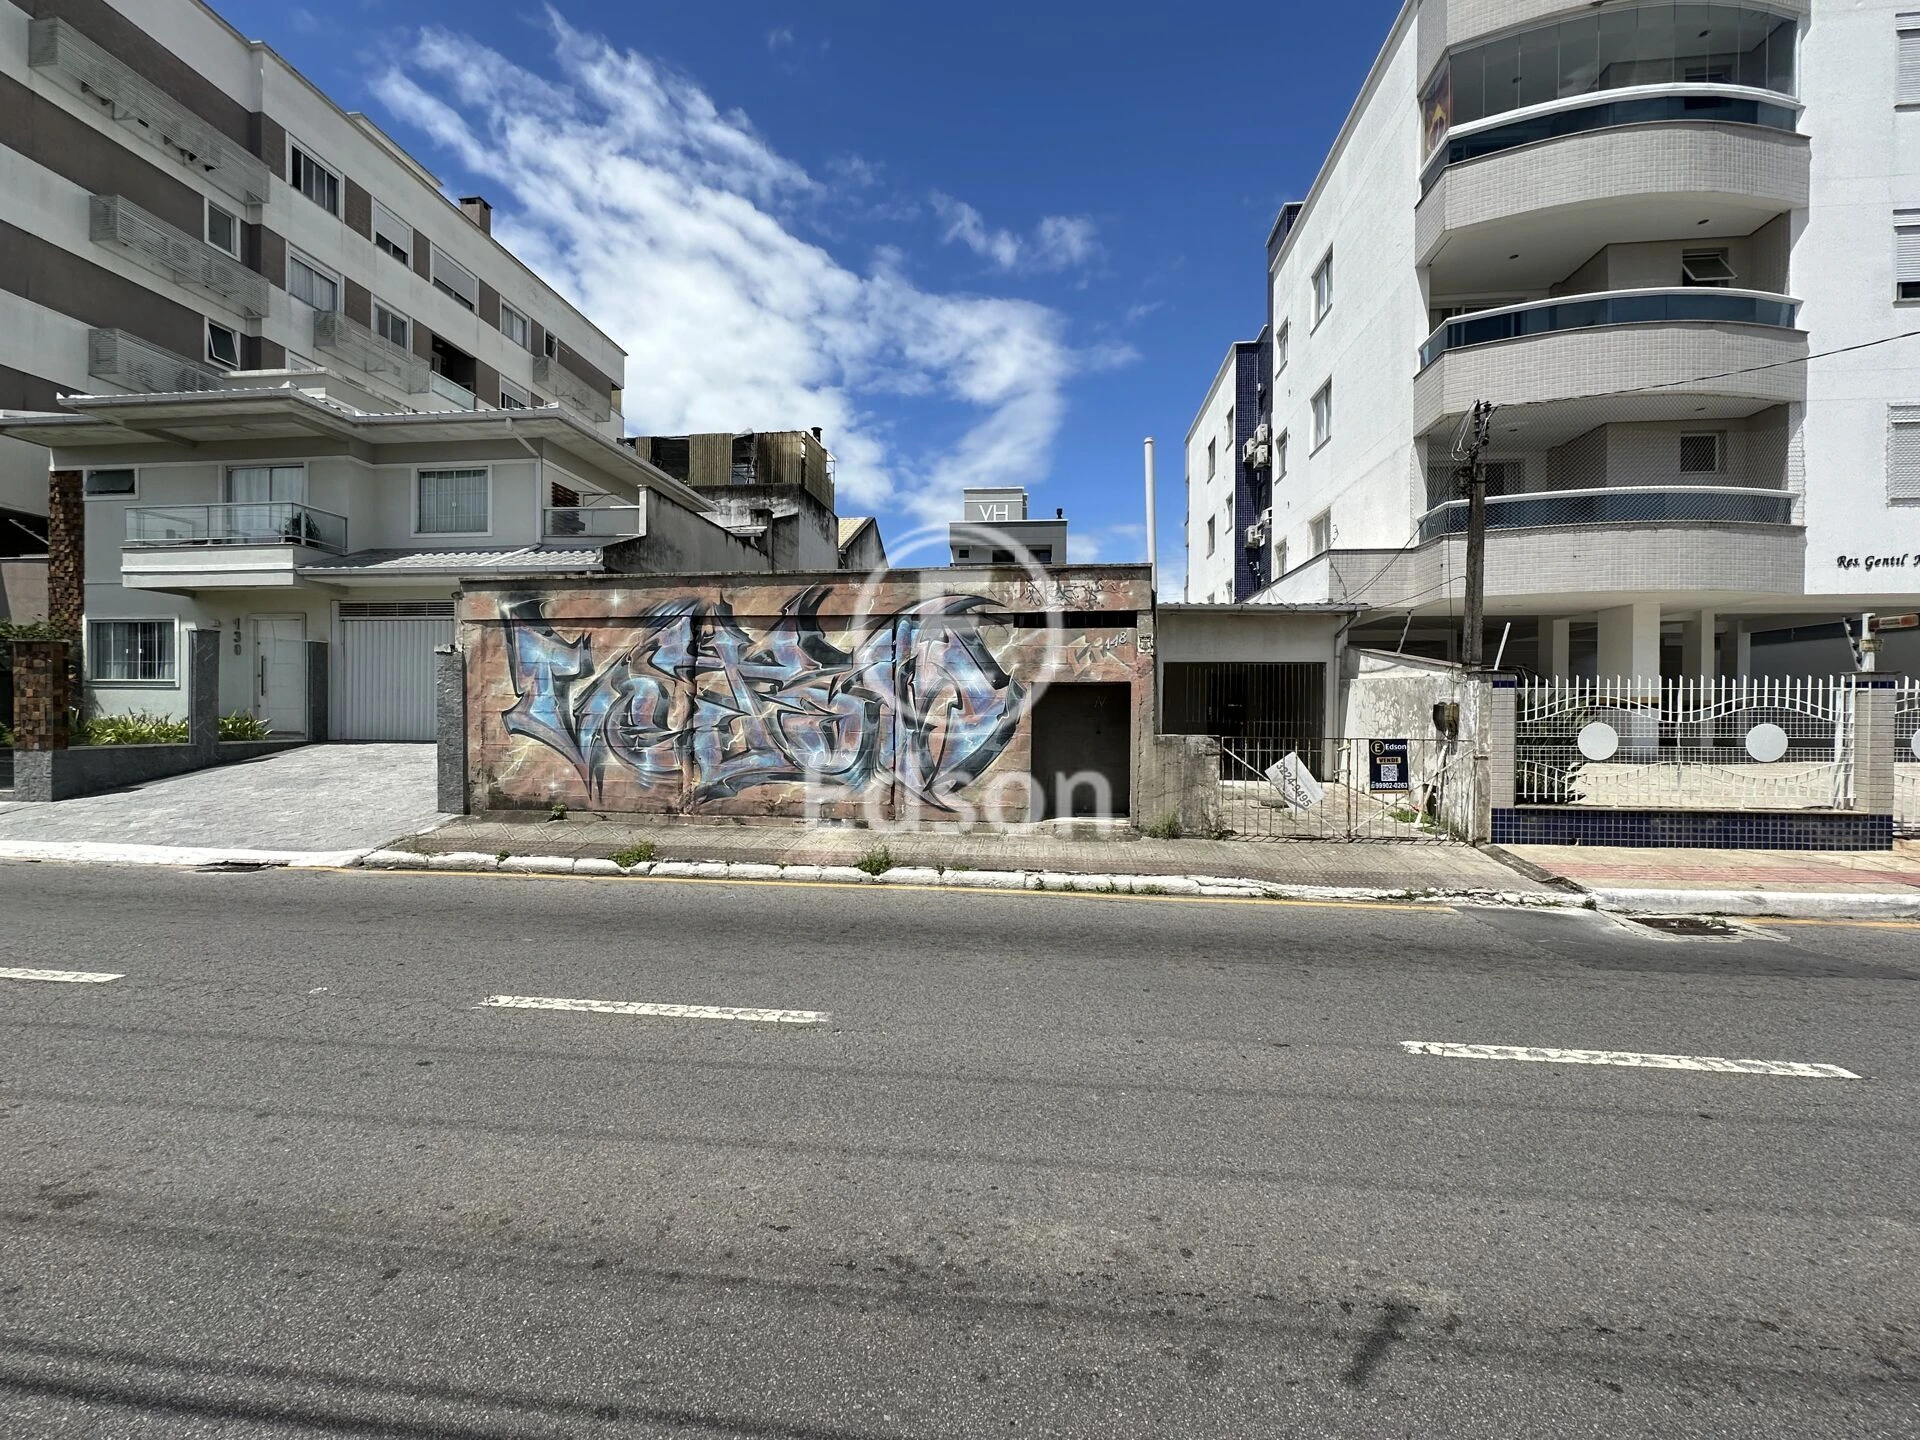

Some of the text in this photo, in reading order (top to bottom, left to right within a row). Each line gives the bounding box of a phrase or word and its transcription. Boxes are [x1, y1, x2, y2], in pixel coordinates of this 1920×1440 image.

[979, 504, 1009, 521] VH
[1864, 553, 1909, 572] Gentil
[1105, 631, 1128, 650] 148
[1385, 743, 1407, 751] Edson
[1276, 761, 1313, 807] 3224-9495
